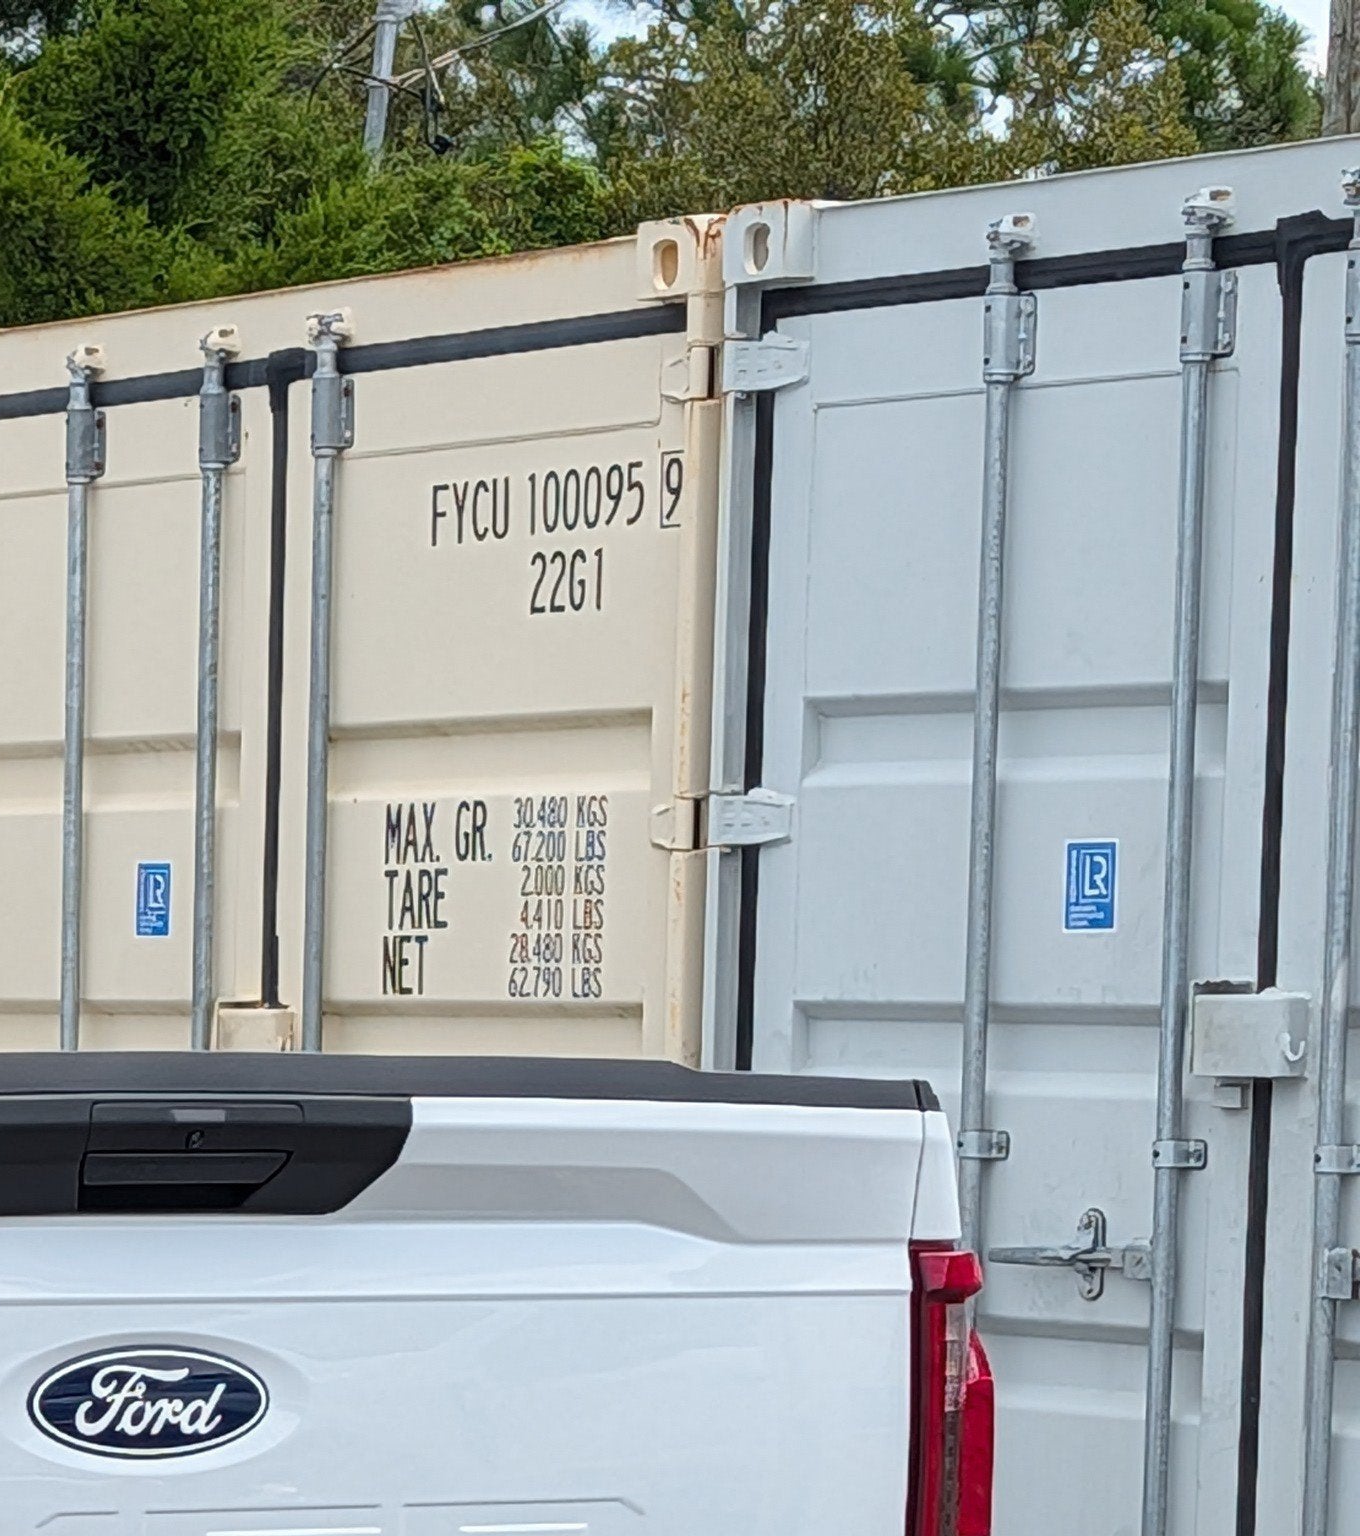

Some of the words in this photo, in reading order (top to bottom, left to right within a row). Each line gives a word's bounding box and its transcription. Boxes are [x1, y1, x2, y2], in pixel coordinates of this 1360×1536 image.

[431, 475, 510, 546] FYCU
[528, 460, 645, 536] 100095
[665, 457, 684, 521] 9
[530, 547, 604, 615] 22G1
[384, 802, 441, 865] MAX.
[455, 800, 493, 862] GR.
[576, 795, 609, 828] KGS
[574, 830, 607, 862] LBS
[384, 868, 448, 930] TARE
[573, 864, 605, 896] KGS
[1084, 855, 1108, 896] LR
[572, 899, 604, 930] LBS
[383, 934, 429, 995] NET
[572, 933, 603, 964] KGS
[571, 966, 602, 998] LBS
[75, 1364, 227, 1436] Ford
